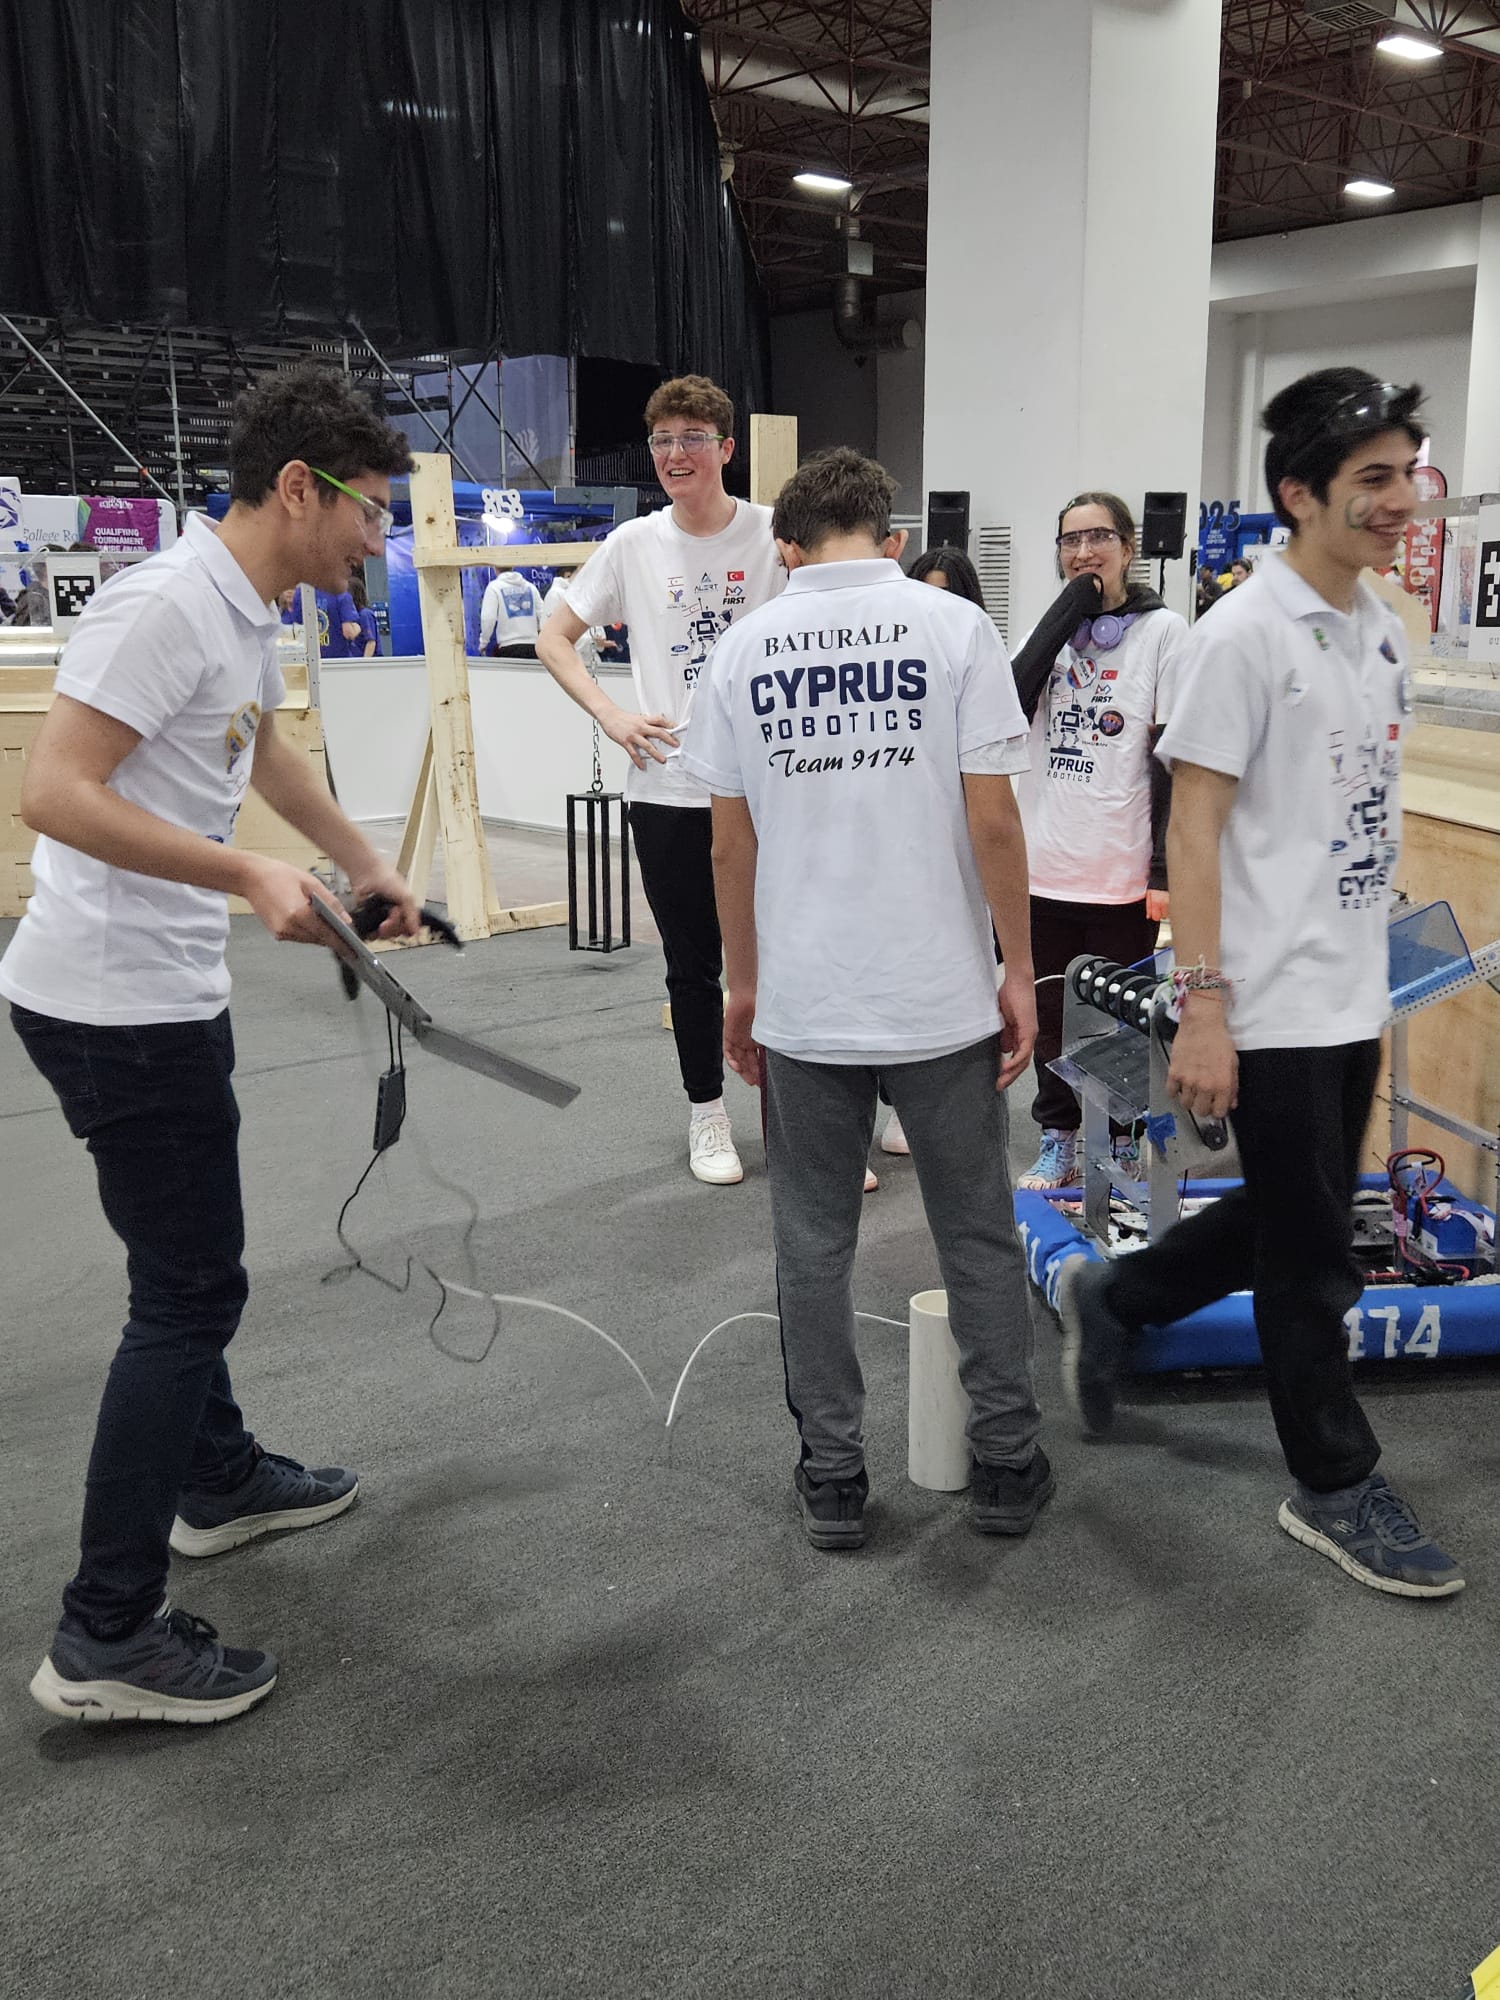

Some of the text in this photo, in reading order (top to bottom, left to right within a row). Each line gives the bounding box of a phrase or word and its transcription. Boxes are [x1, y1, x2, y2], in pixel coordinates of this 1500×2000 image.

[482, 489, 524, 518] 8158
[1200, 500, 1240, 531] 025
[63, 529, 78, 542] Ro
[92, 536, 145, 545] TOURNAMENT
[95, 527, 140, 537] QUALIFYING
[723, 596, 746, 605] FIRST
[763, 623, 908, 657] BATURALP
[750, 659, 927, 716] CYPRUS
[1090, 695, 1113, 703] FIRST
[760, 709, 922, 743] ROBOTICS
[768, 746, 915, 778] Team 9174
[1048, 756, 1095, 774] YPRUS
[1343, 1305, 1441, 1362] 174
